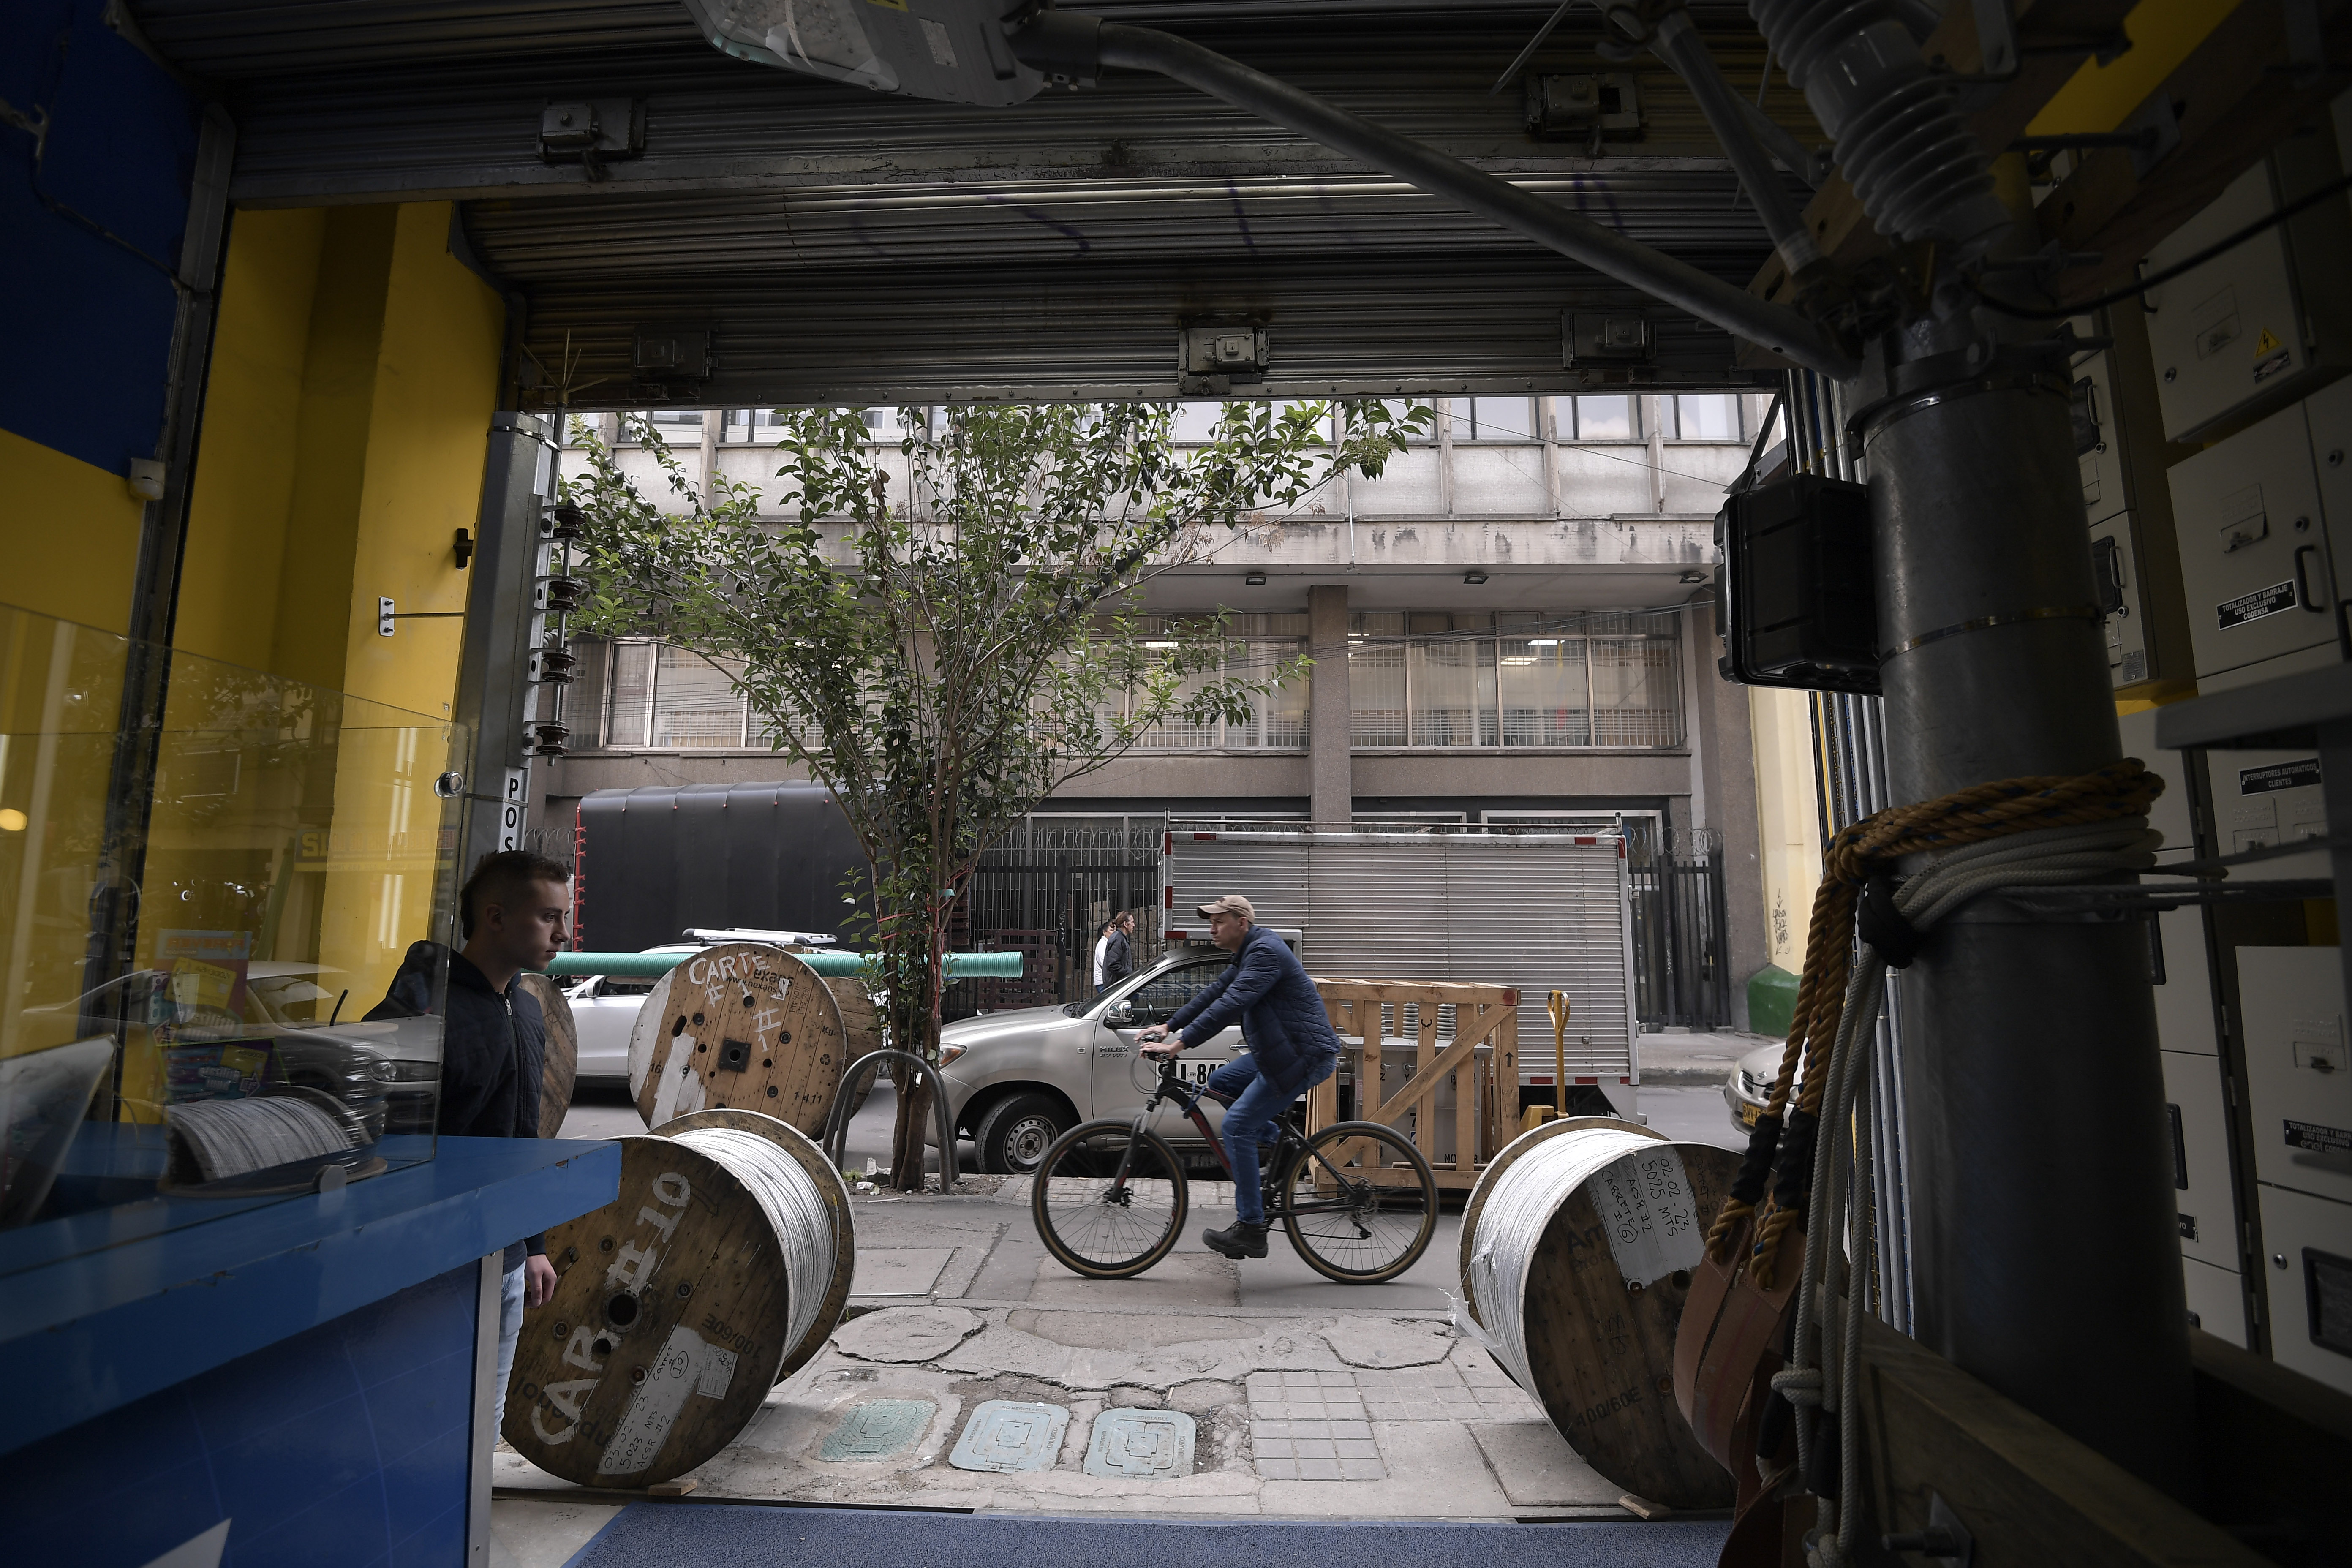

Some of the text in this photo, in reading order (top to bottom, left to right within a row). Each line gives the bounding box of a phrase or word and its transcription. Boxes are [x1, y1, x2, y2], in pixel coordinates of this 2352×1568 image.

[2222, 596, 2257, 612] TOTALIZADOR
[2262, 585, 2288, 599] BARRAJE
[2235, 596, 2276, 615] USO EXCLUSIVO
[2243, 607, 2268, 620] CODENSA
[2243, 763, 2316, 781] INTERRUPTORES AUTOMATICOS
[2268, 778, 2291, 787] CLIENTES
[2288, 1122, 2328, 1136] TOTALIZADOR
[1602, 1170, 1636, 1226] CARRETE
[1626, 1179, 1646, 1211] ACSR
[1642, 1160, 1679, 1237] 5025 MTS
[1621, 1228, 1634, 1239] 6
[620, 1410, 658, 1469] 5023 MTS
[637, 1439, 656, 1468] ACSR
